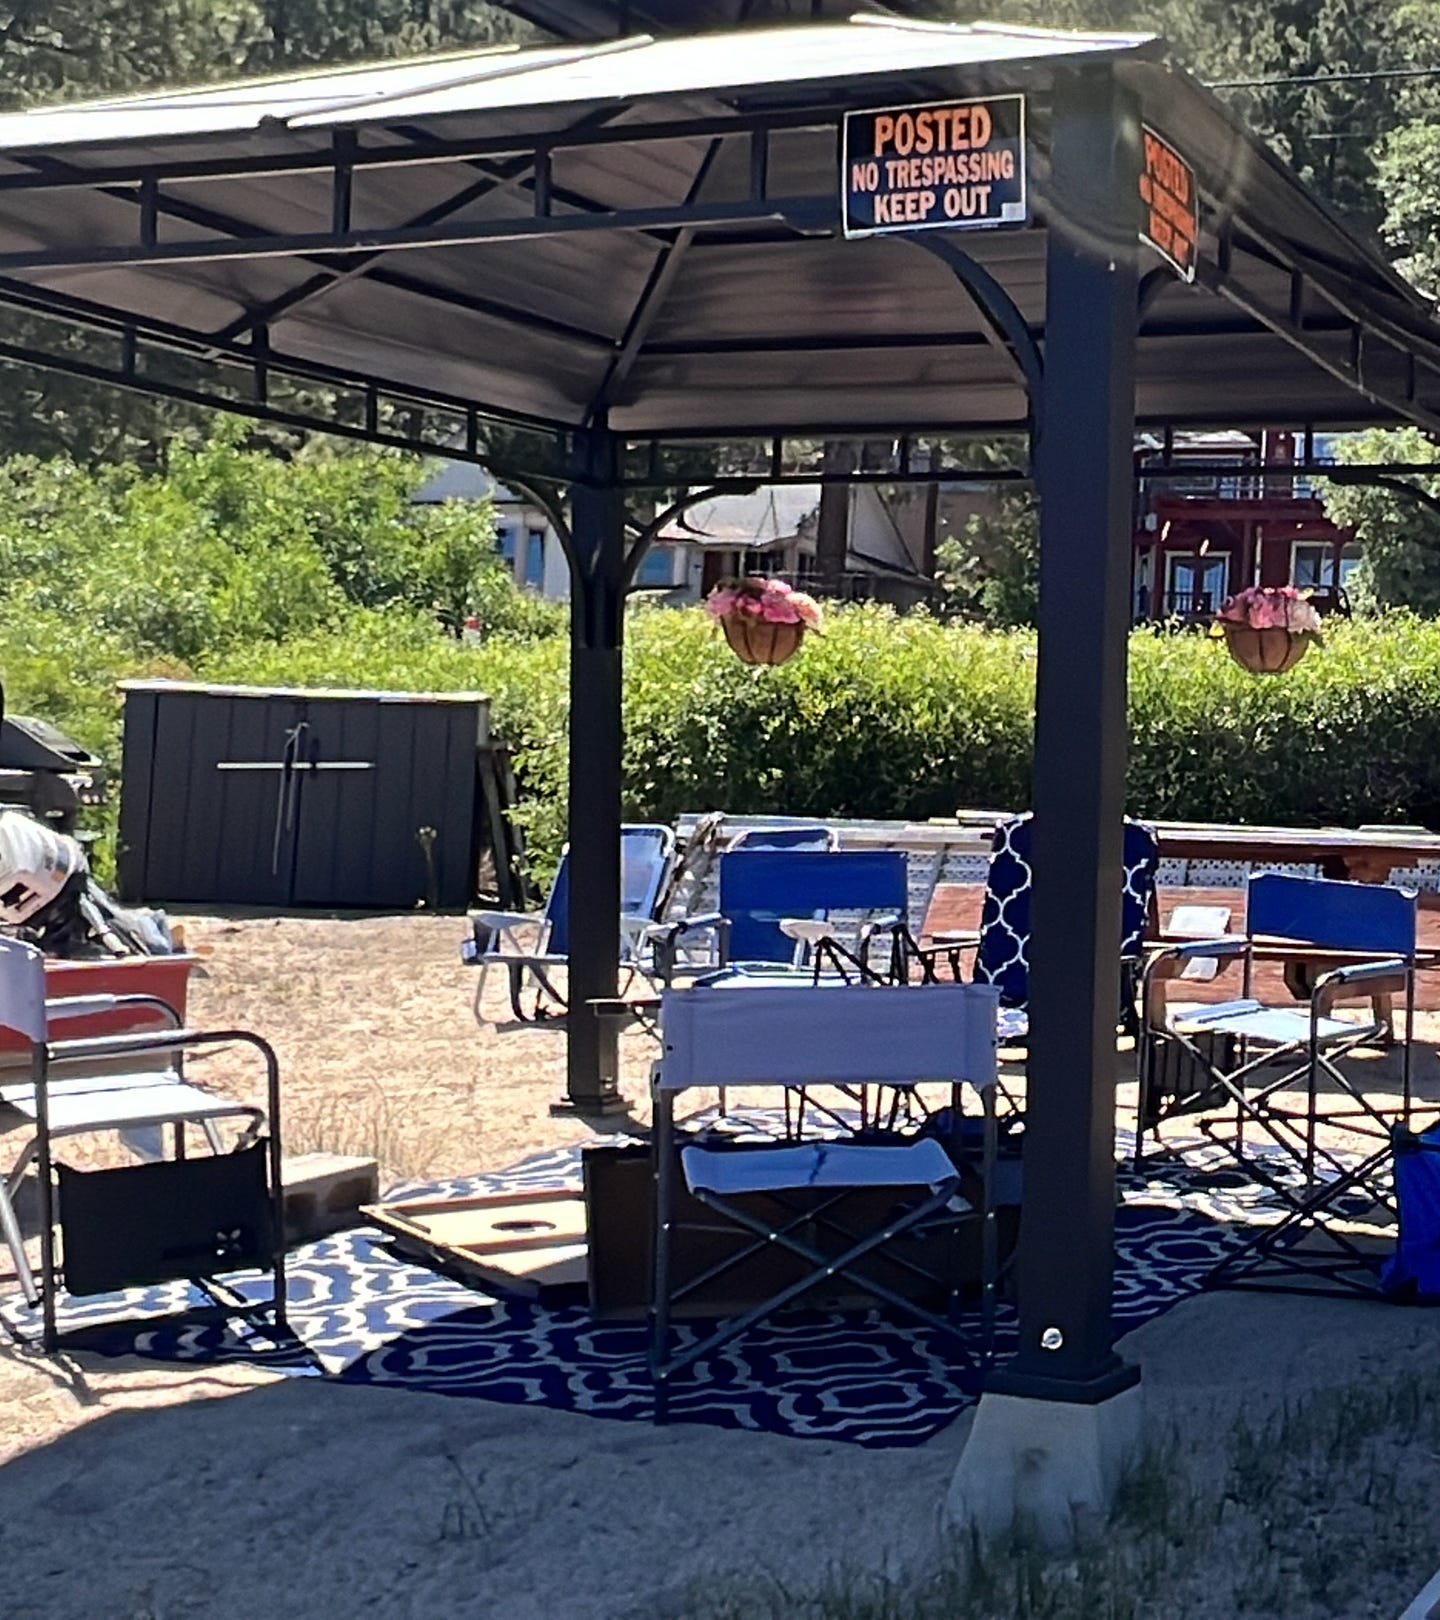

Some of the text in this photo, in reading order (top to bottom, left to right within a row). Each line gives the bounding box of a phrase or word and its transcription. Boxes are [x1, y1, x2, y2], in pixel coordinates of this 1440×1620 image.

[874, 104, 992, 157] POSTED
[852, 150, 1014, 193] NO TRESPASSING
[874, 190, 936, 225] KEEP
[943, 185, 992, 219] OUT
